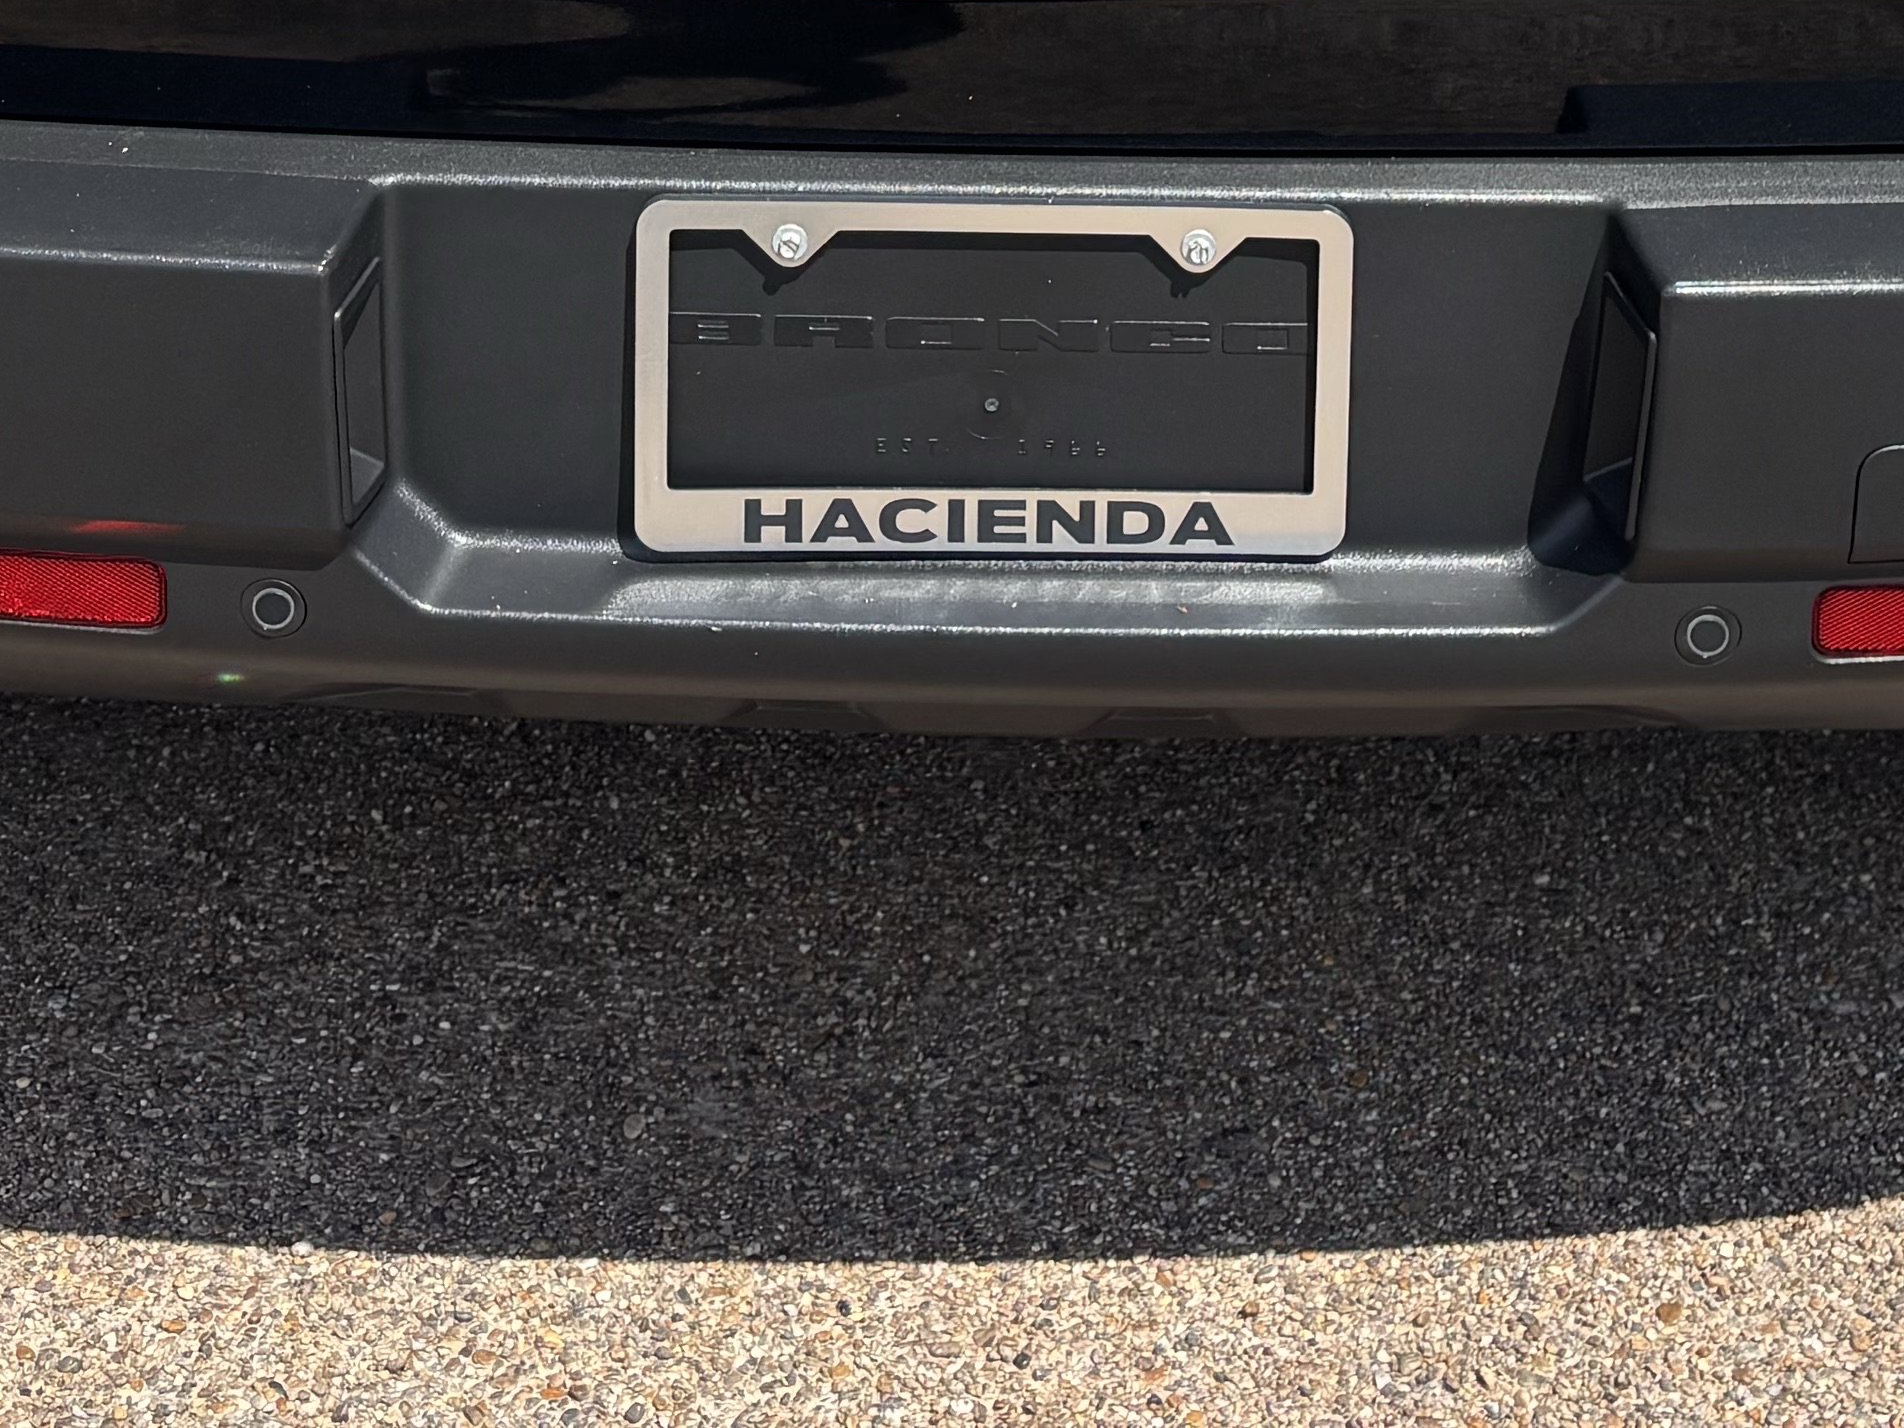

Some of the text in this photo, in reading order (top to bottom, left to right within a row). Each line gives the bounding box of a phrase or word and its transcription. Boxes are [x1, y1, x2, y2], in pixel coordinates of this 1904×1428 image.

[669, 312, 1308, 355] BRONCO
[1017, 439, 1108, 458] 1966
[743, 498, 1236, 547] HACIENDA
